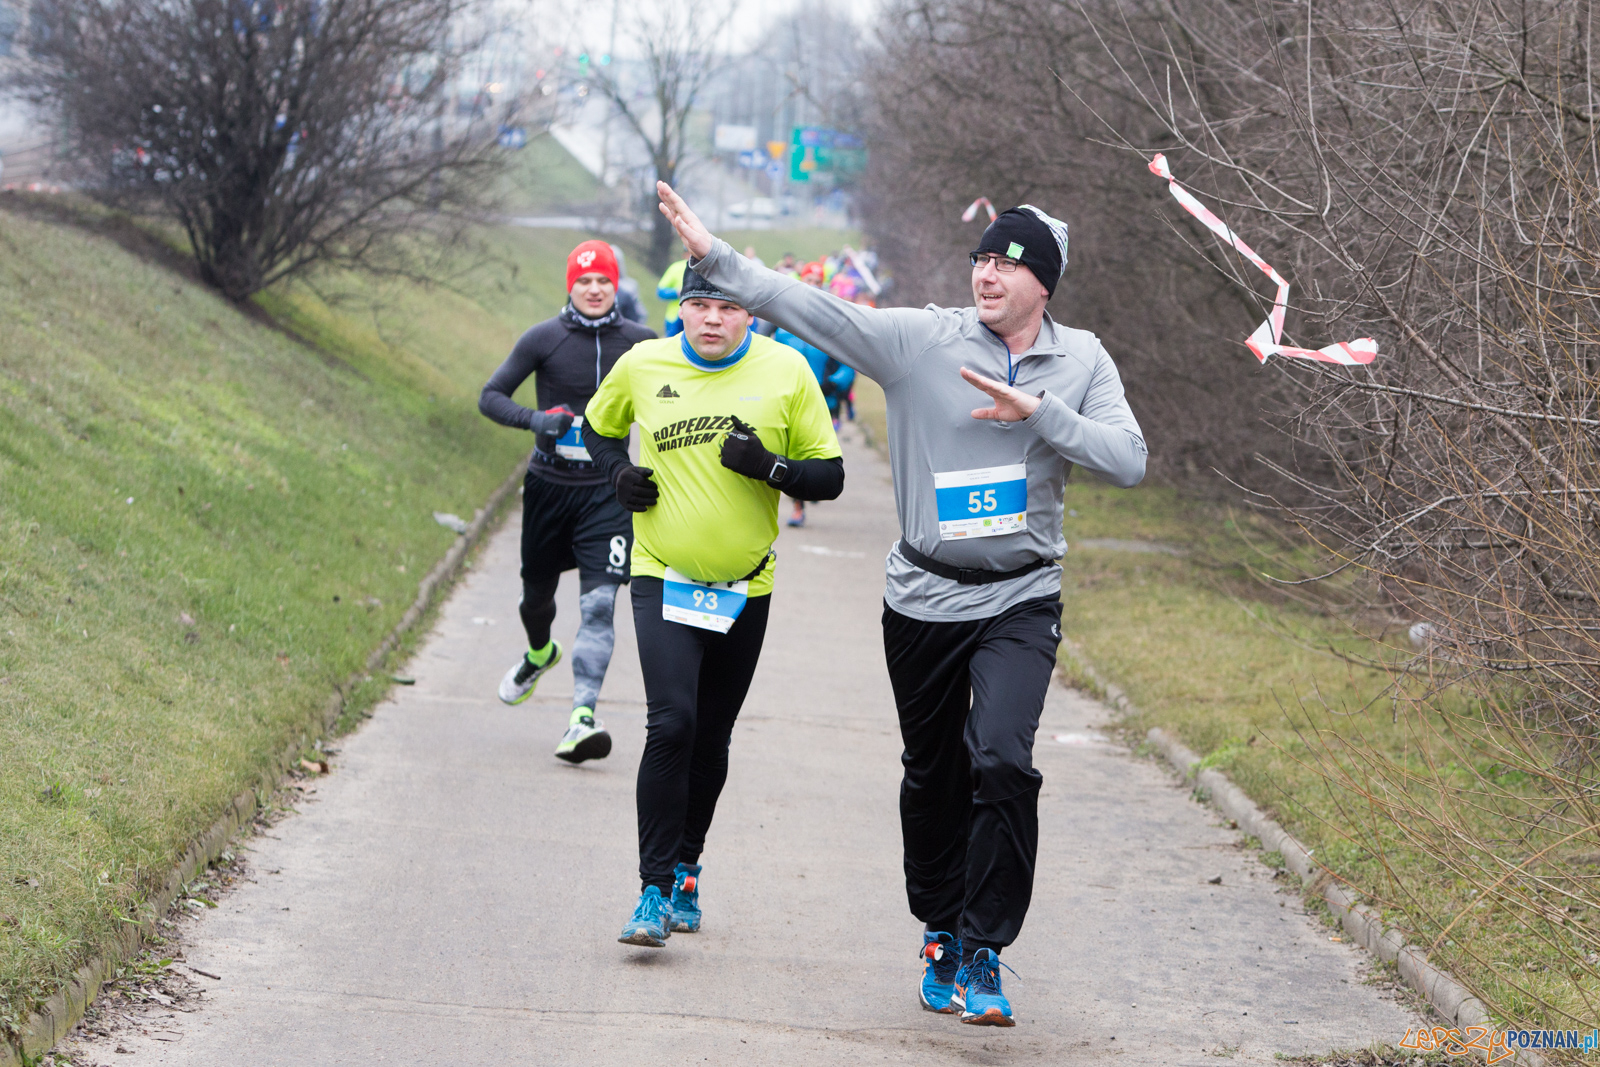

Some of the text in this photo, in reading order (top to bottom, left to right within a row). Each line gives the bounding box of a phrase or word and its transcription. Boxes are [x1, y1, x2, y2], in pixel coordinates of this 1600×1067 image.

[653, 416, 757, 442] ROZPĘDZE
[656, 432, 718, 453] WIATREM
[968, 489, 997, 513] 55
[608, 535, 627, 567] 8
[693, 590, 718, 610] 93
